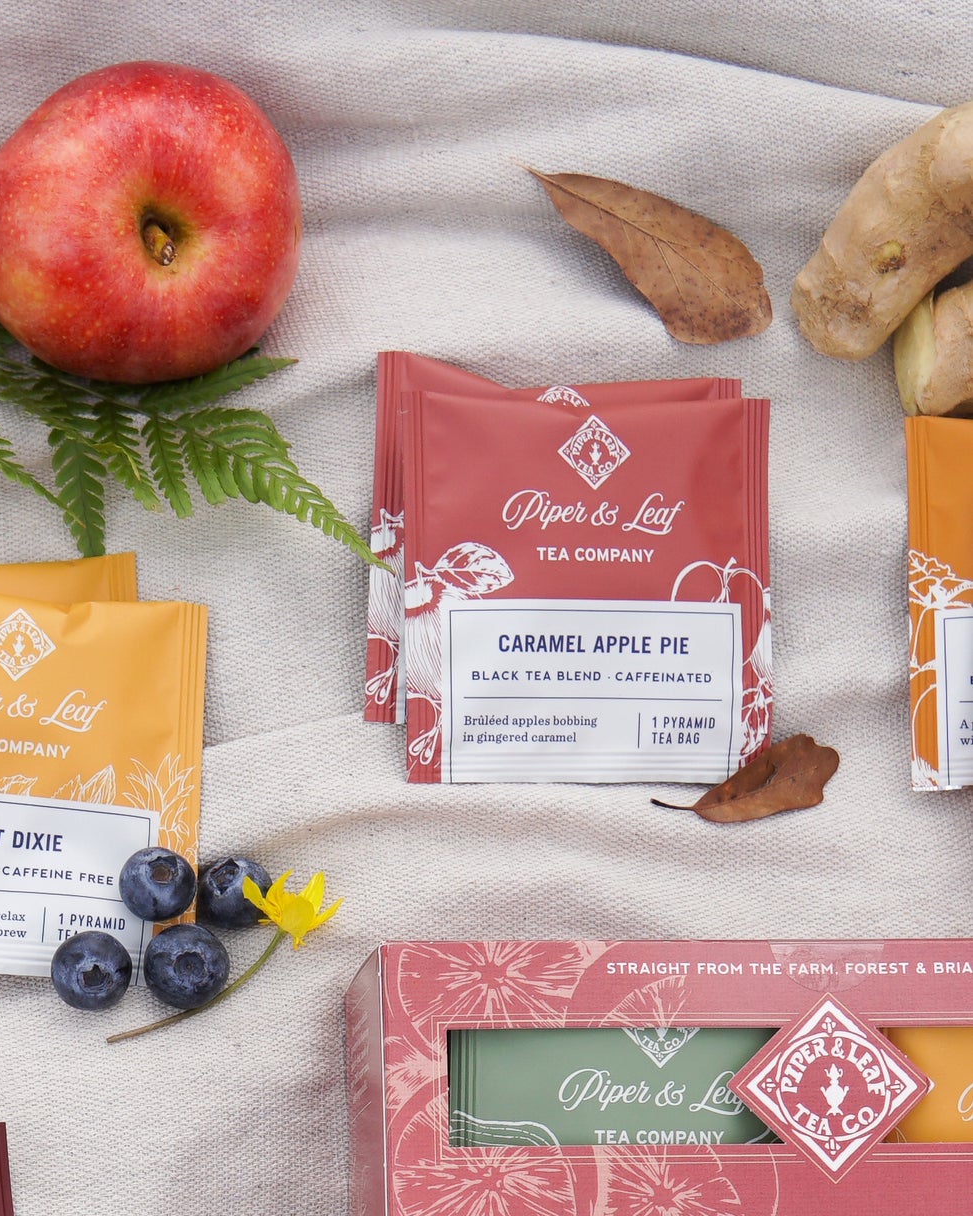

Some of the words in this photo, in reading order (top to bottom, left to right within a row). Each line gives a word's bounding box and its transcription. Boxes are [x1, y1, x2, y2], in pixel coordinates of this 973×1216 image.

[572, 431, 594, 455] PIPER
[594, 429, 601, 441] &
[578, 459, 594, 474] TEA
[502, 490, 588, 530] Piper
[591, 502, 619, 526] &
[622, 493, 685, 535] Leaf
[536, 547, 569, 561] TEA
[575, 548, 654, 562] COMPANY
[499, 635, 585, 653] CARAMEL
[593, 636, 651, 654] APPLE
[660, 637, 689, 654] PIE
[472, 671, 519, 680] BLACK
[525, 671, 551, 681] TEA
[557, 671, 601, 681] BLEND
[615, 672, 712, 683] CAFFEINATED
[7, 693, 38, 718] &
[39, 689, 107, 732] Leaf
[464, 715, 509, 726] Brûléed
[512, 715, 550, 728] apples
[553, 715, 597, 728] bobbing
[652, 716, 657, 728] 1
[663, 716, 715, 729] PYRAMID
[463, 732, 474, 742] in
[477, 731, 527, 744] gingered
[531, 732, 576, 742] caramel
[652, 732, 672, 744] TEA
[678, 732, 700, 744] BAG
[12, 831, 63, 852] DIXIE
[2, 866, 72, 880] CAFFEINE
[80, 873, 114, 886] FREE
[59, 913, 63, 925] 1
[70, 914, 125, 930] PYRAMID
[58, 928, 78, 941] TE
[607, 962, 690, 974] STRAIGHT
[697, 963, 742, 974] FROM
[749, 963, 782, 975] THE
[845, 963, 909, 974] FOREST
[916, 962, 927, 974] &
[641, 1036, 659, 1051] TEA
[780, 1038, 830, 1094] PIPER
[830, 1037, 845, 1059] &
[559, 1069, 651, 1111] Piper
[655, 1081, 686, 1106] &
[793, 1102, 832, 1136] TEA
[841, 1106, 879, 1134] CO.
[594, 1130, 630, 1144] TEA
[636, 1130, 724, 1144] COMPANY
